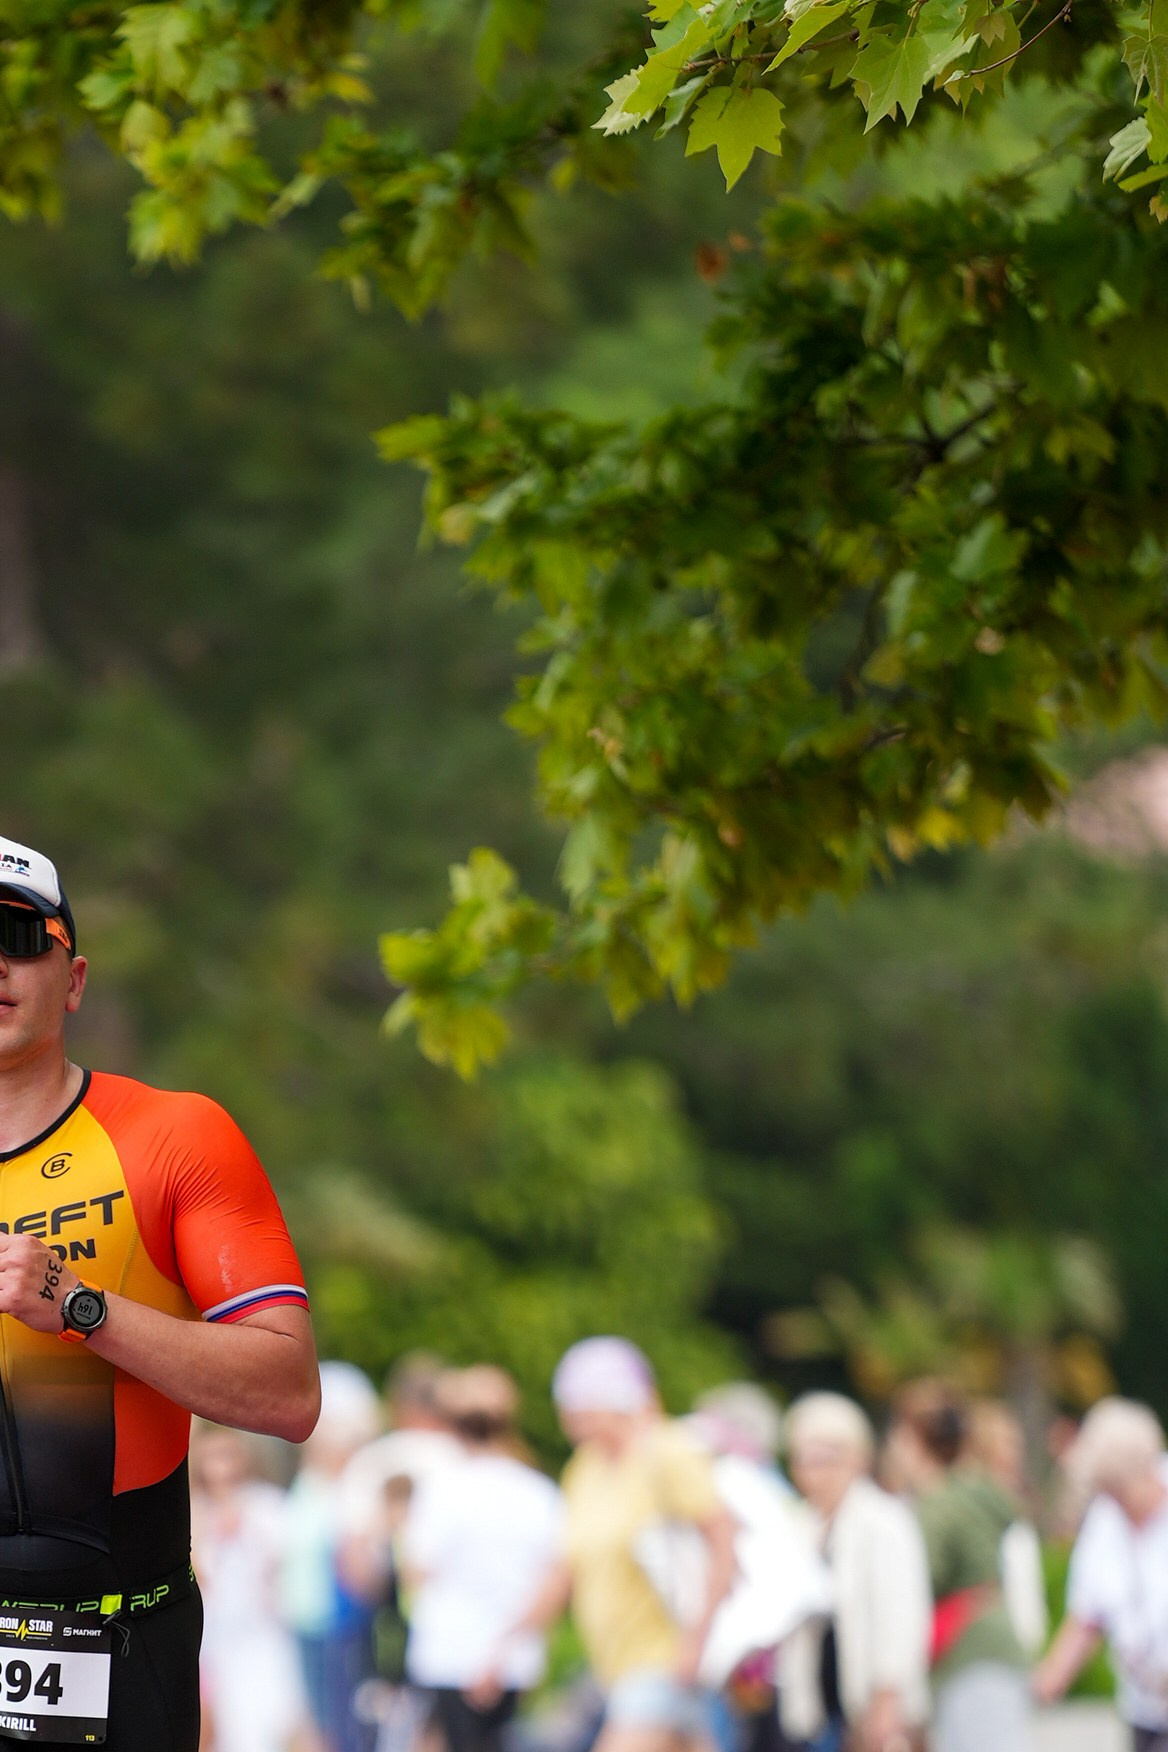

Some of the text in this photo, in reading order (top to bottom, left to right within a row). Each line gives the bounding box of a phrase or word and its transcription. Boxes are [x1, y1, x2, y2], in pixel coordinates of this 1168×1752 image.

[39, 1259, 63, 1302] 394
[28, 1618, 53, 1633] STAR
[72, 1629, 101, 1637] МАГНИТ
